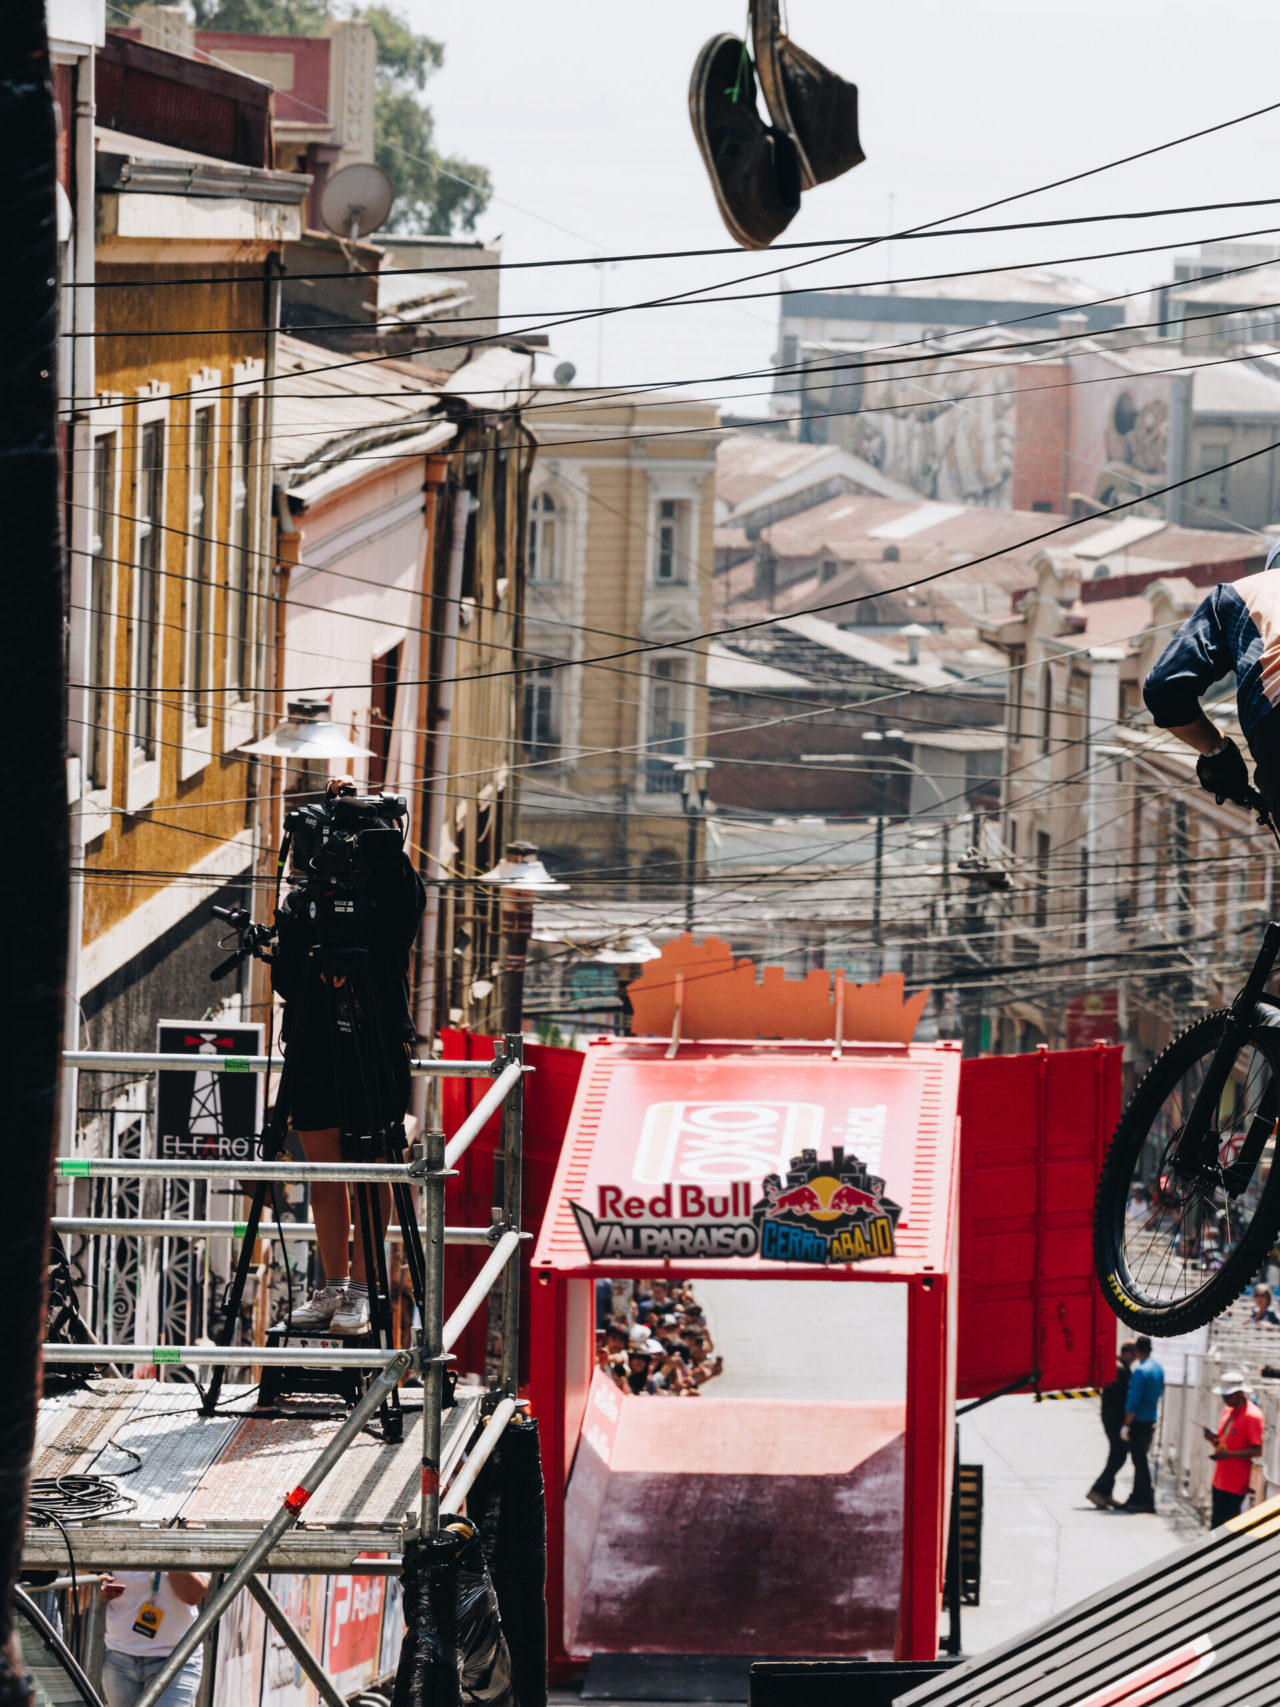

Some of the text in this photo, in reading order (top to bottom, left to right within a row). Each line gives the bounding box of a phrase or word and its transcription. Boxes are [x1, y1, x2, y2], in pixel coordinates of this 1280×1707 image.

[163, 1135, 249, 1157] EL FARO
[678, 1104, 780, 1181] OXXO
[598, 1181, 750, 1218] Red Bull
[573, 1203, 757, 1259] VALPARAISO
[763, 1218, 892, 1260] CERRO ABAJO
[1107, 1273, 1142, 1312] MAXXIS
